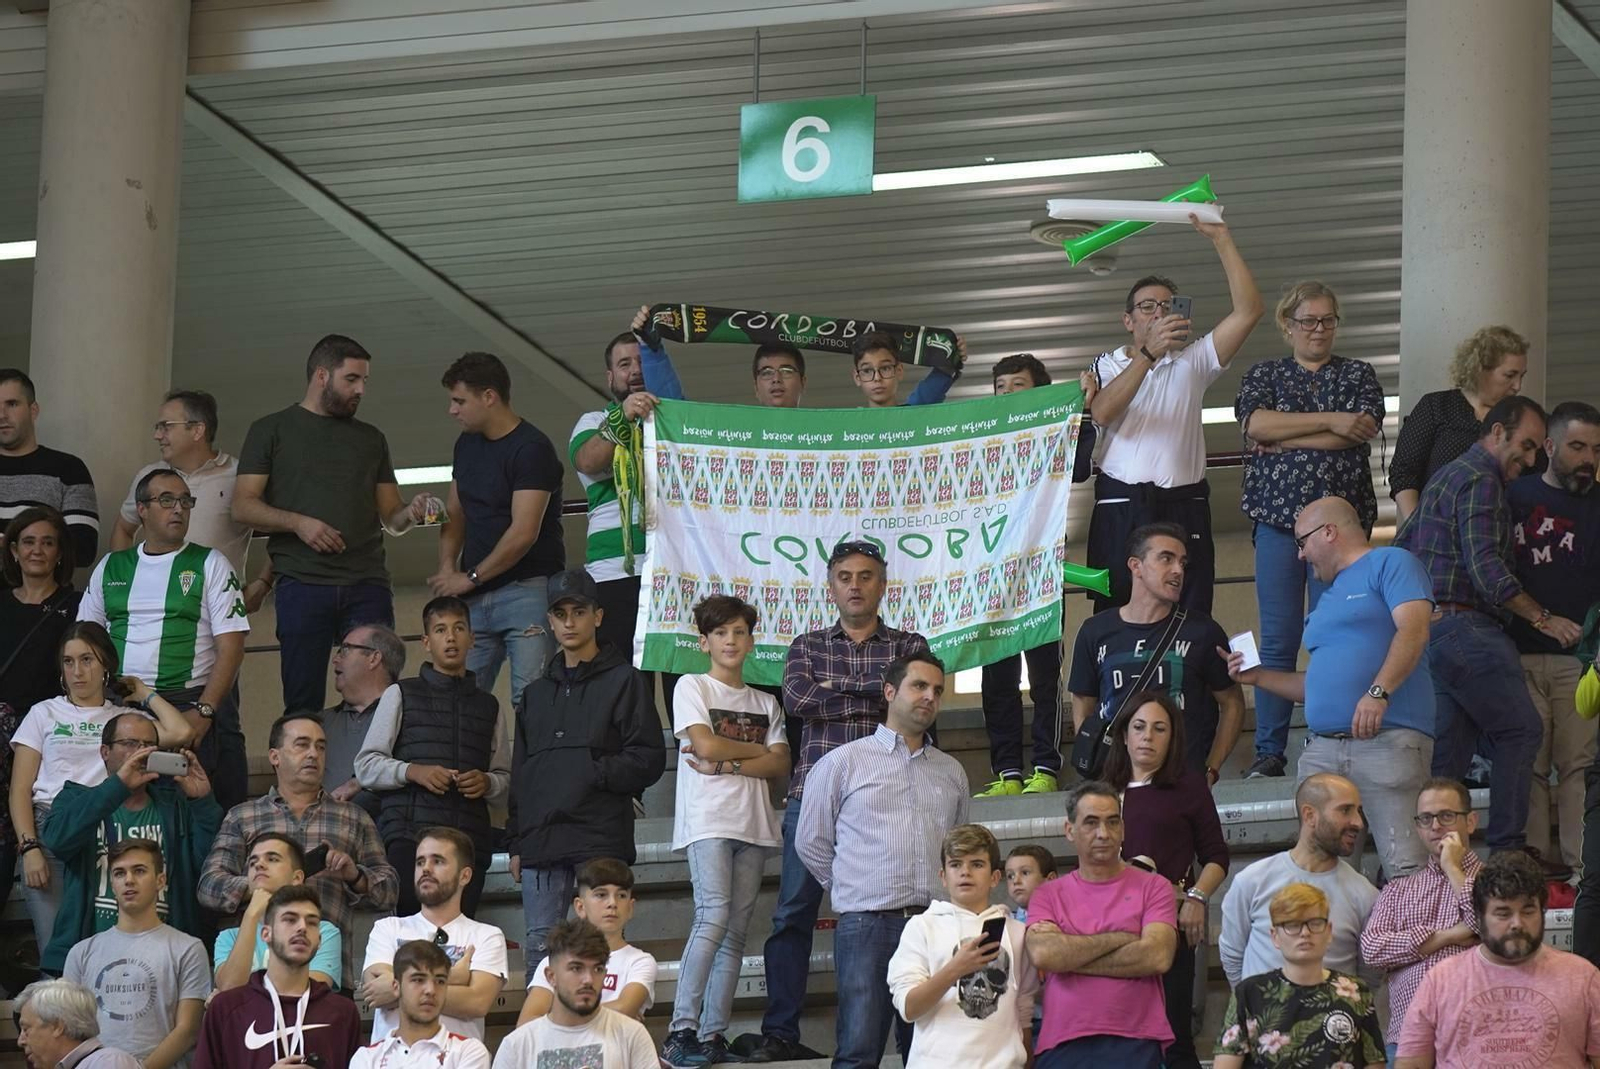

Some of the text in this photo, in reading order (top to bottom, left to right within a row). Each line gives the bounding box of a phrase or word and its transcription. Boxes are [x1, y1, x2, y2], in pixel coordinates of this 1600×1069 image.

[782, 115, 831, 183] 6
[692, 306, 707, 333] 1954
[105, 983, 146, 994] QUIKSILVER
